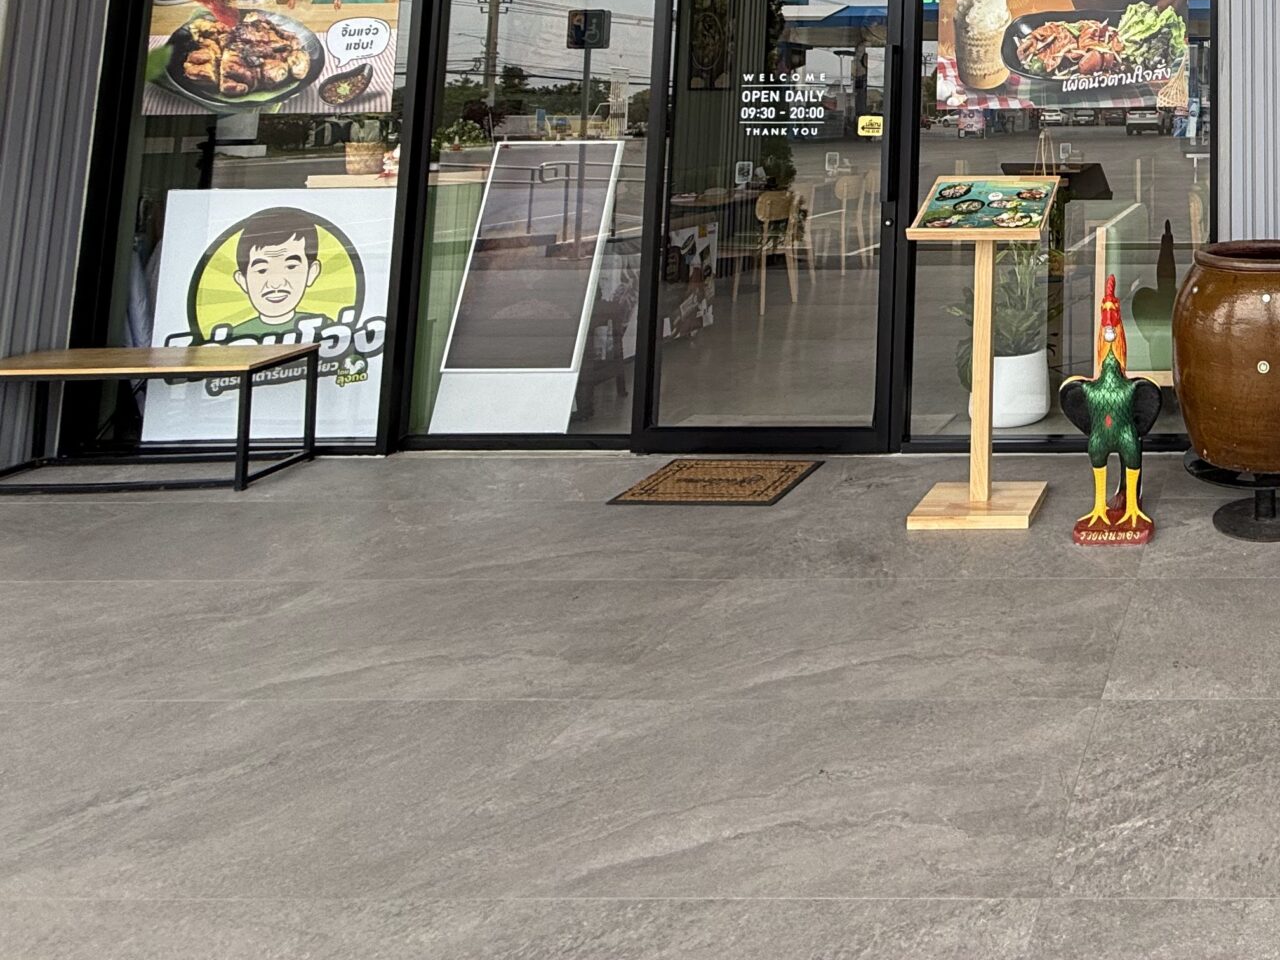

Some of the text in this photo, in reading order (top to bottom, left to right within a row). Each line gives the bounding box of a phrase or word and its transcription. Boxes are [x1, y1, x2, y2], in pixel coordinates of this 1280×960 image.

[340, 25, 380, 38] จิ้มแจ่ว
[345, 38, 374, 51] แซ่บ!
[742, 73, 826, 82] WELCOME
[1061, 59, 1172, 93] เผ็ดนัวตามใจสั่ง
[741, 90, 825, 103] OPEN DAILY
[740, 106, 776, 119] 09:30
[789, 106, 825, 119] 20:00
[745, 127, 819, 136] THANK YOU
